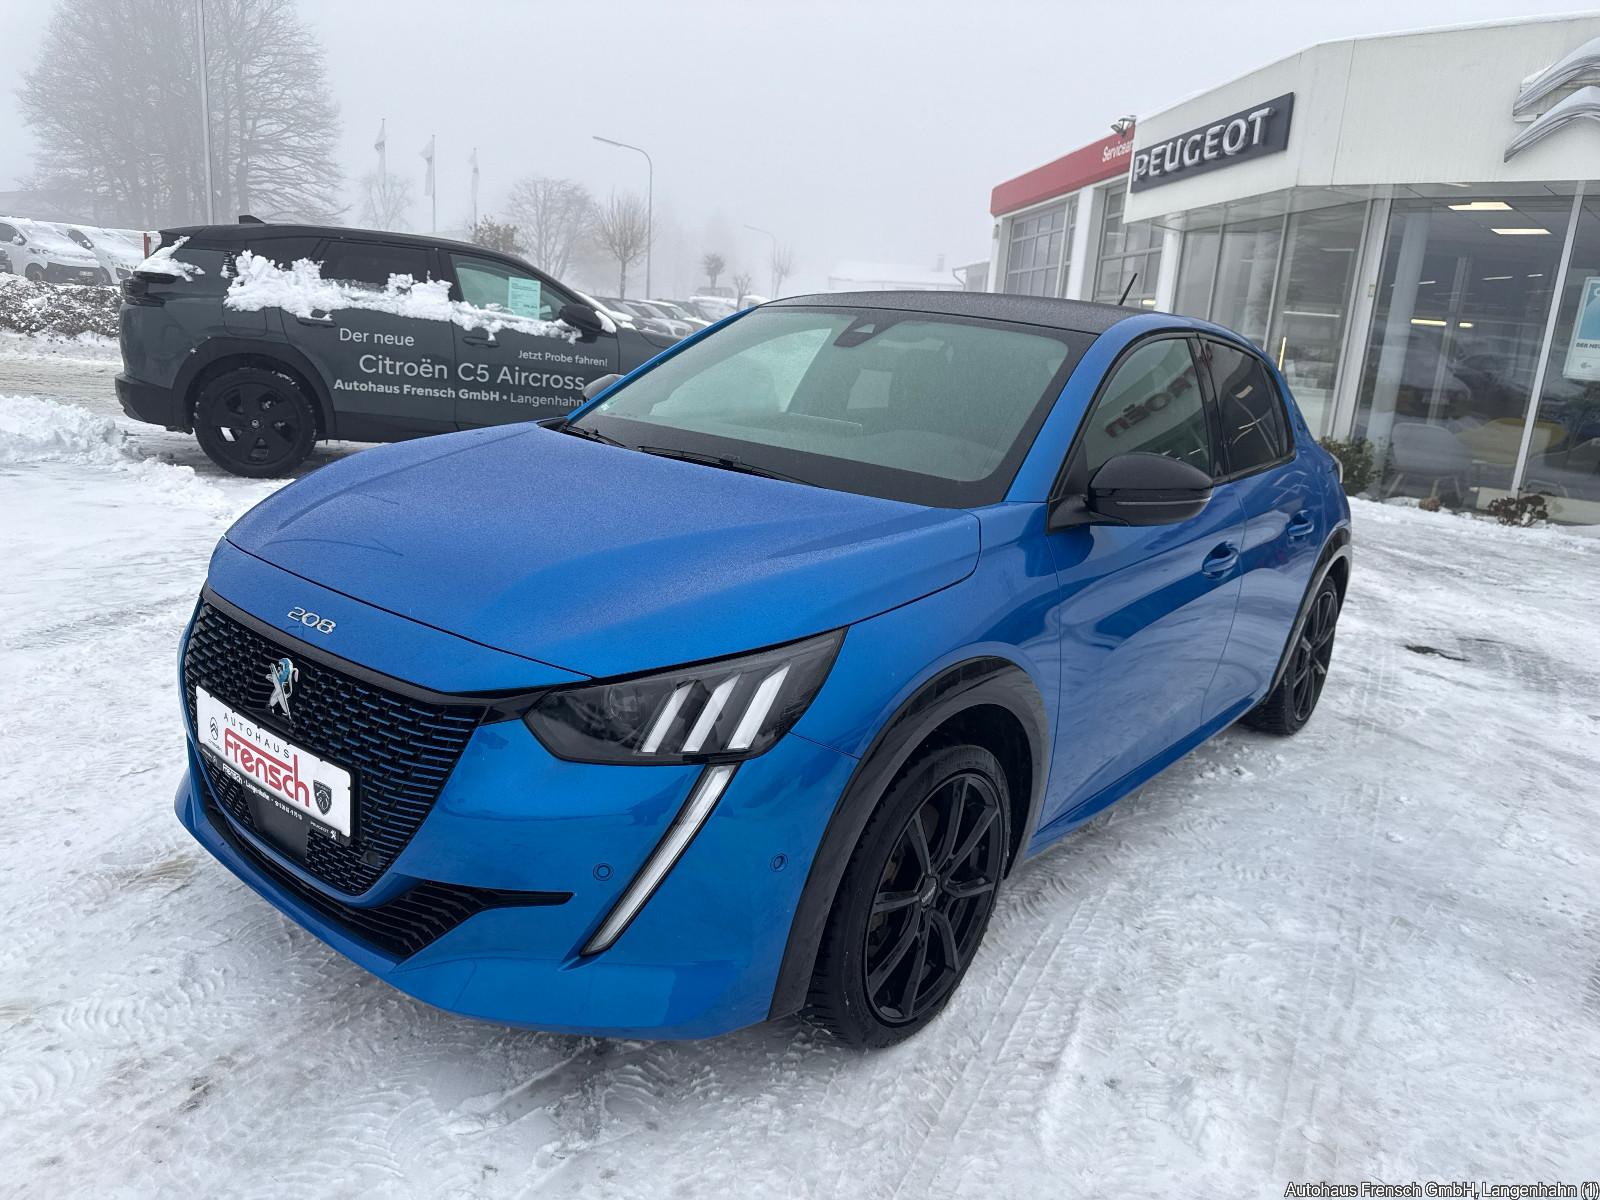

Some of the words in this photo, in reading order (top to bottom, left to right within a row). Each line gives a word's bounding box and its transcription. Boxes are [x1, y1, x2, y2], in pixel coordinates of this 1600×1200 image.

[1134, 107, 1275, 182] PEUGEOT
[339, 328, 368, 342] Der
[374, 333, 415, 347] neue
[359, 354, 448, 379] Citroën
[457, 362, 490, 382] C5
[497, 366, 585, 391] Aircross
[518, 349, 542, 361] Jetzt
[545, 352, 572, 363] Probe
[575, 354, 608, 367] fahren!
[334, 379, 399, 394] Autohaus
[403, 384, 456, 398] Frensch
[459, 388, 500, 402] GmbH
[510, 392, 584, 407] Langenhahn
[287, 606, 337, 635] 208
[223, 712, 290, 759] AUTOHAUS
[224, 727, 310, 808] Frensch
